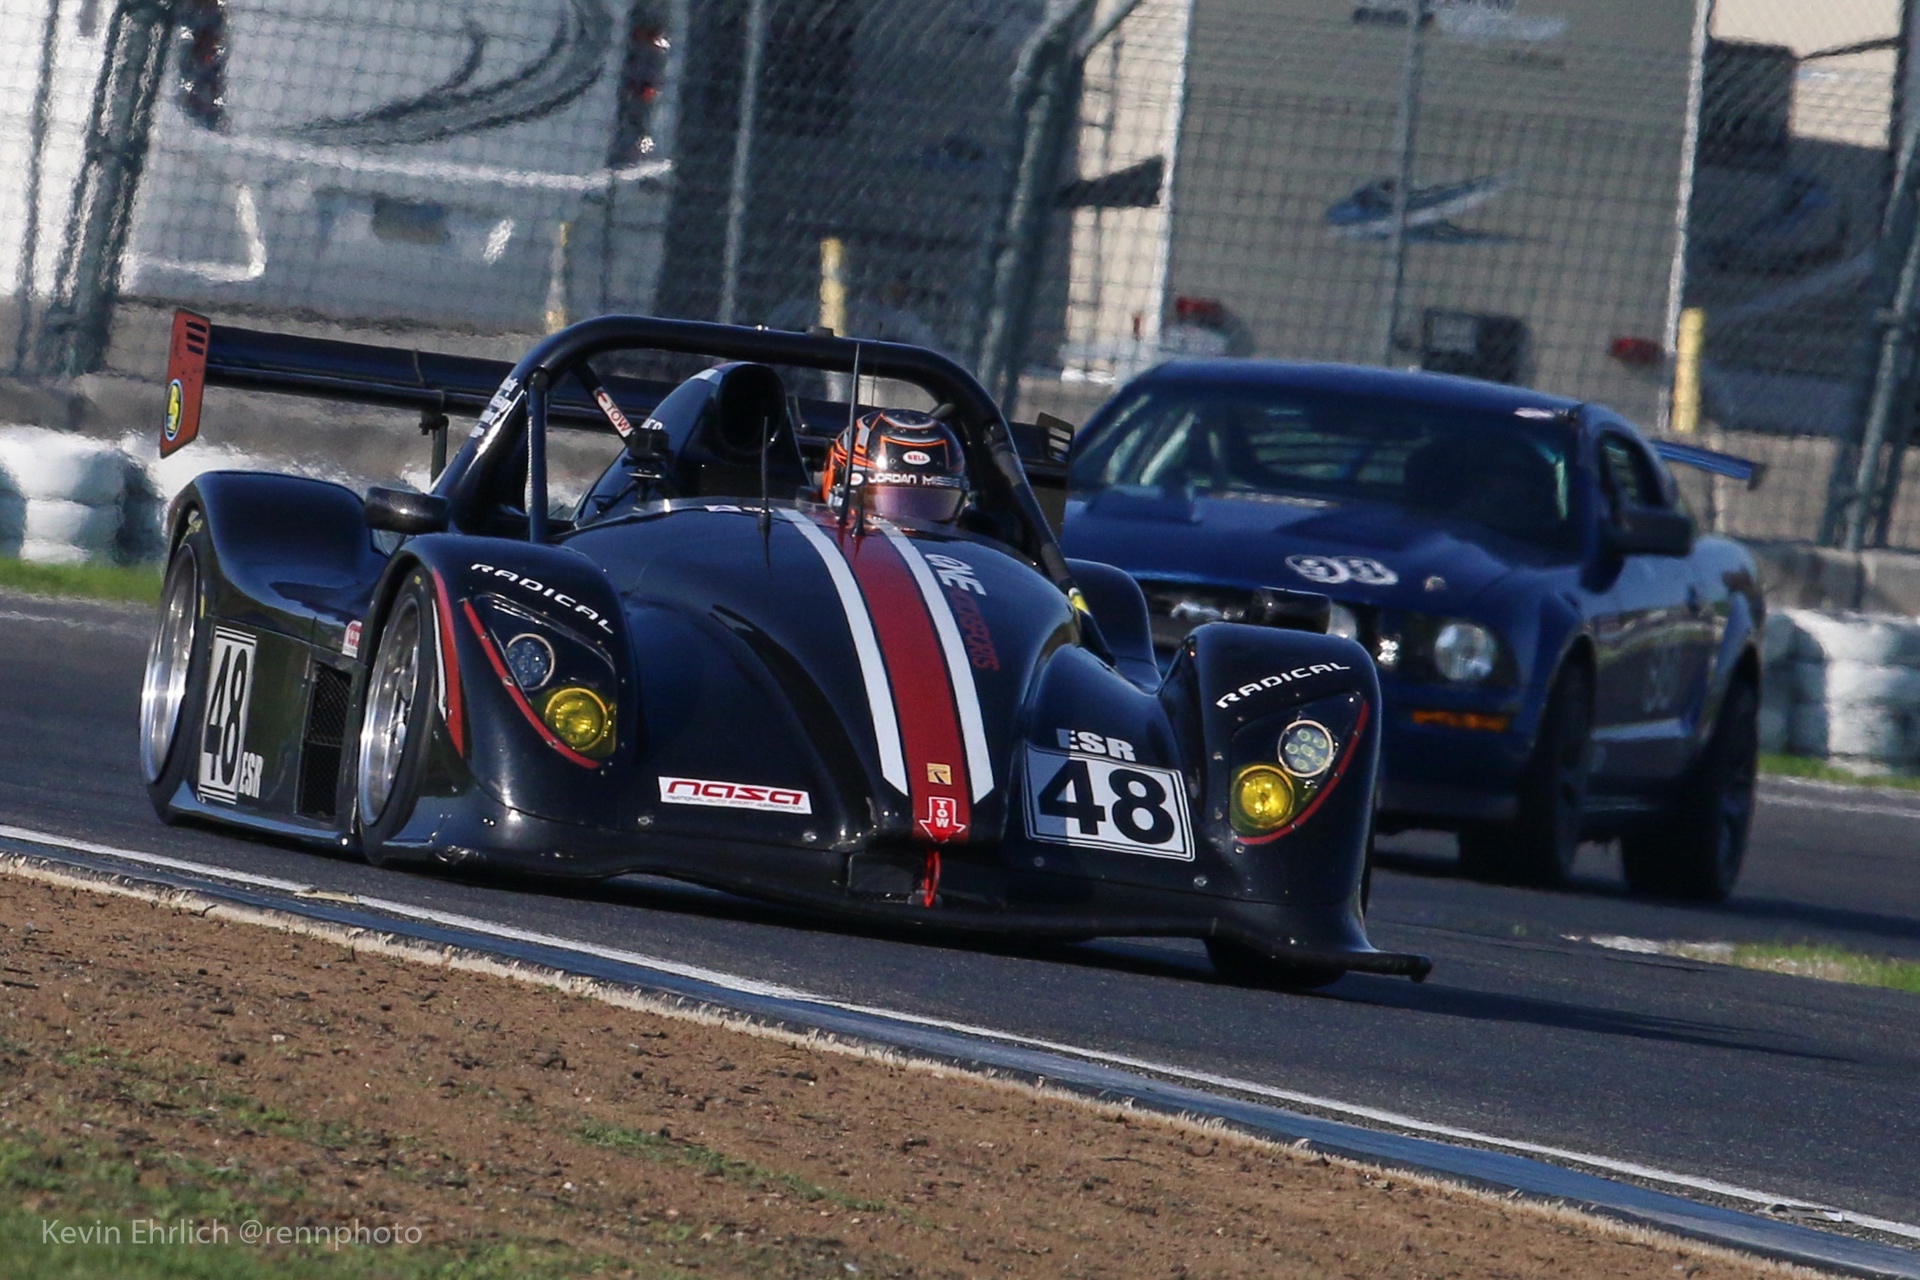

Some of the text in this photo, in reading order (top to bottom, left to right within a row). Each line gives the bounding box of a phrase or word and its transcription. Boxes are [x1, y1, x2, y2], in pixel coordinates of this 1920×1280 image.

[606, 402, 631, 432] TOW
[908, 454, 927, 462] BELL
[868, 473, 917, 484] JORDAN
[470, 563, 614, 634] RADICAL
[1216, 662, 1350, 709] RADICAL
[204, 645, 248, 786] 48
[1056, 728, 1137, 762] ESR
[238, 751, 264, 799] ESR
[935, 800, 950, 829] TOW
[1038, 759, 1175, 845] 48
